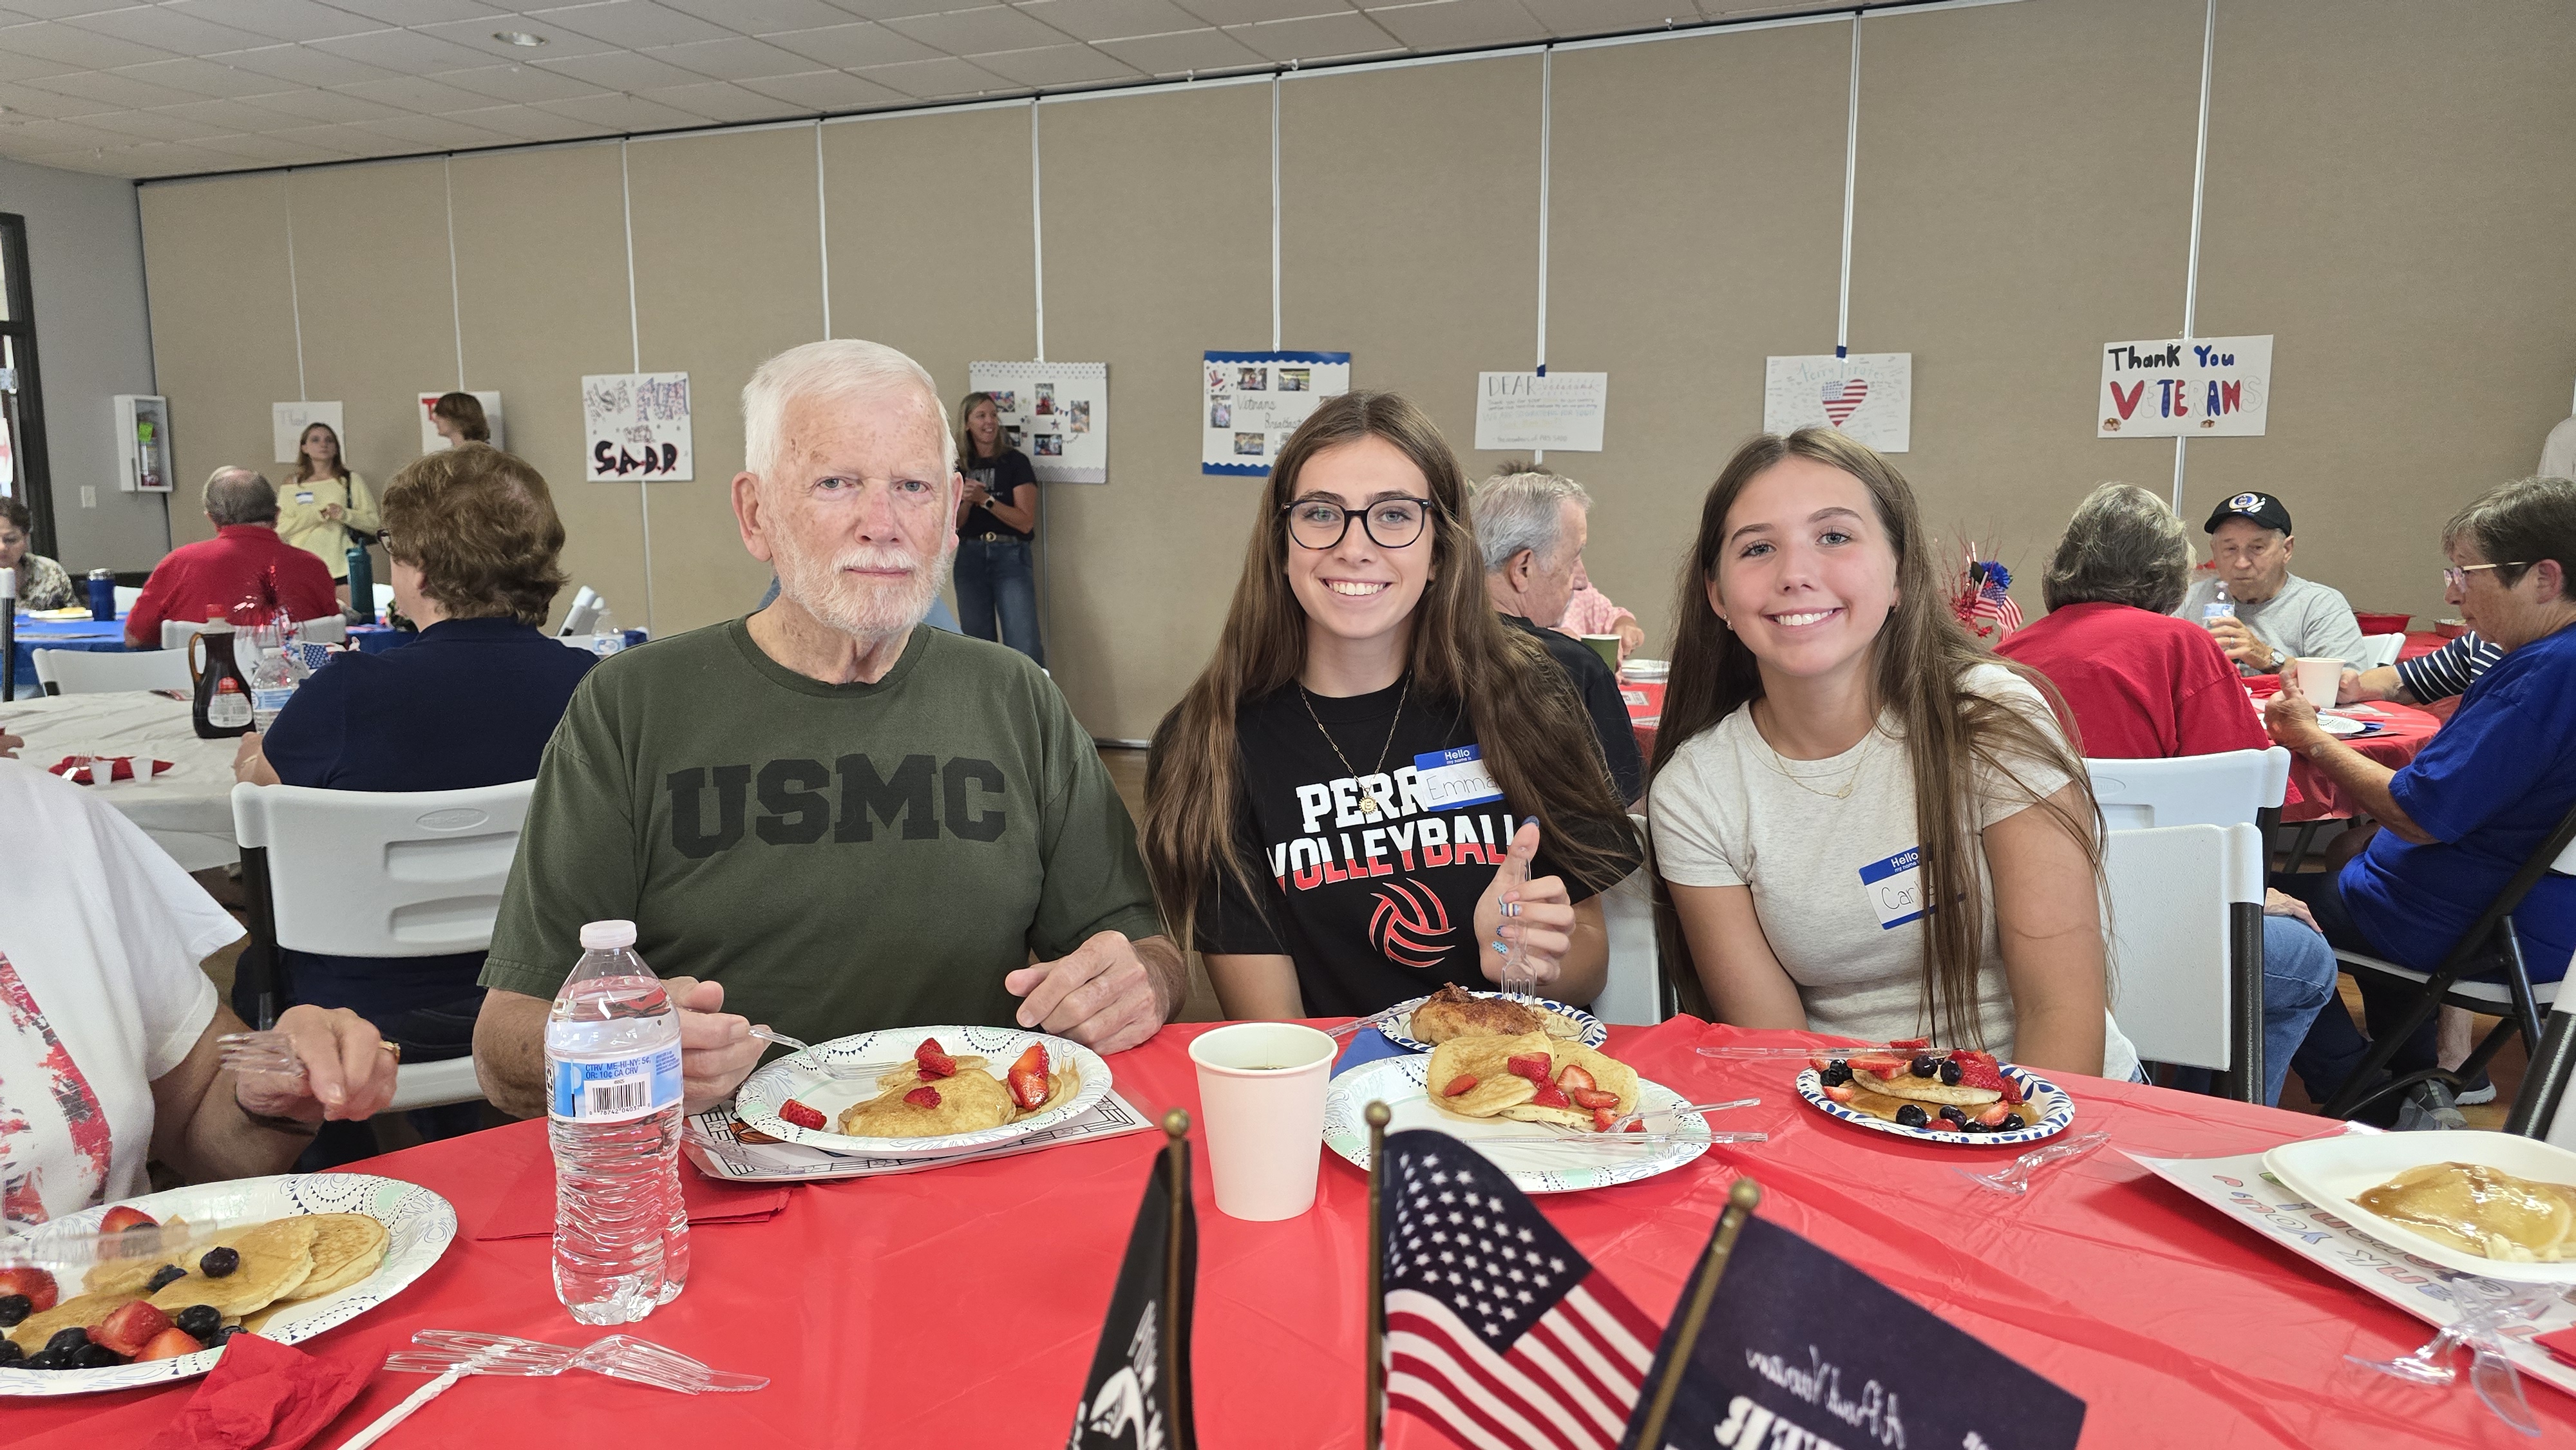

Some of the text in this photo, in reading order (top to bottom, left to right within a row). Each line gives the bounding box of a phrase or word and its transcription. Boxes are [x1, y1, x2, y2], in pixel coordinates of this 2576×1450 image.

[2193, 344, 2235, 368] You
[1488, 375, 1537, 397] DEAR
[2109, 375, 2264, 420] VETERANS
[1444, 749, 1470, 760] Hello
[1295, 765, 1430, 834] PERR
[1427, 775, 1498, 801] Emma
[666, 753, 1007, 860] USMC
[1890, 852, 1918, 868] Hello
[585, 1071, 598, 1080] OR:
[614, 1069, 623, 1077] CA
[625, 1066, 639, 1075] CRV
[621, 1104, 640, 1113] 04037
